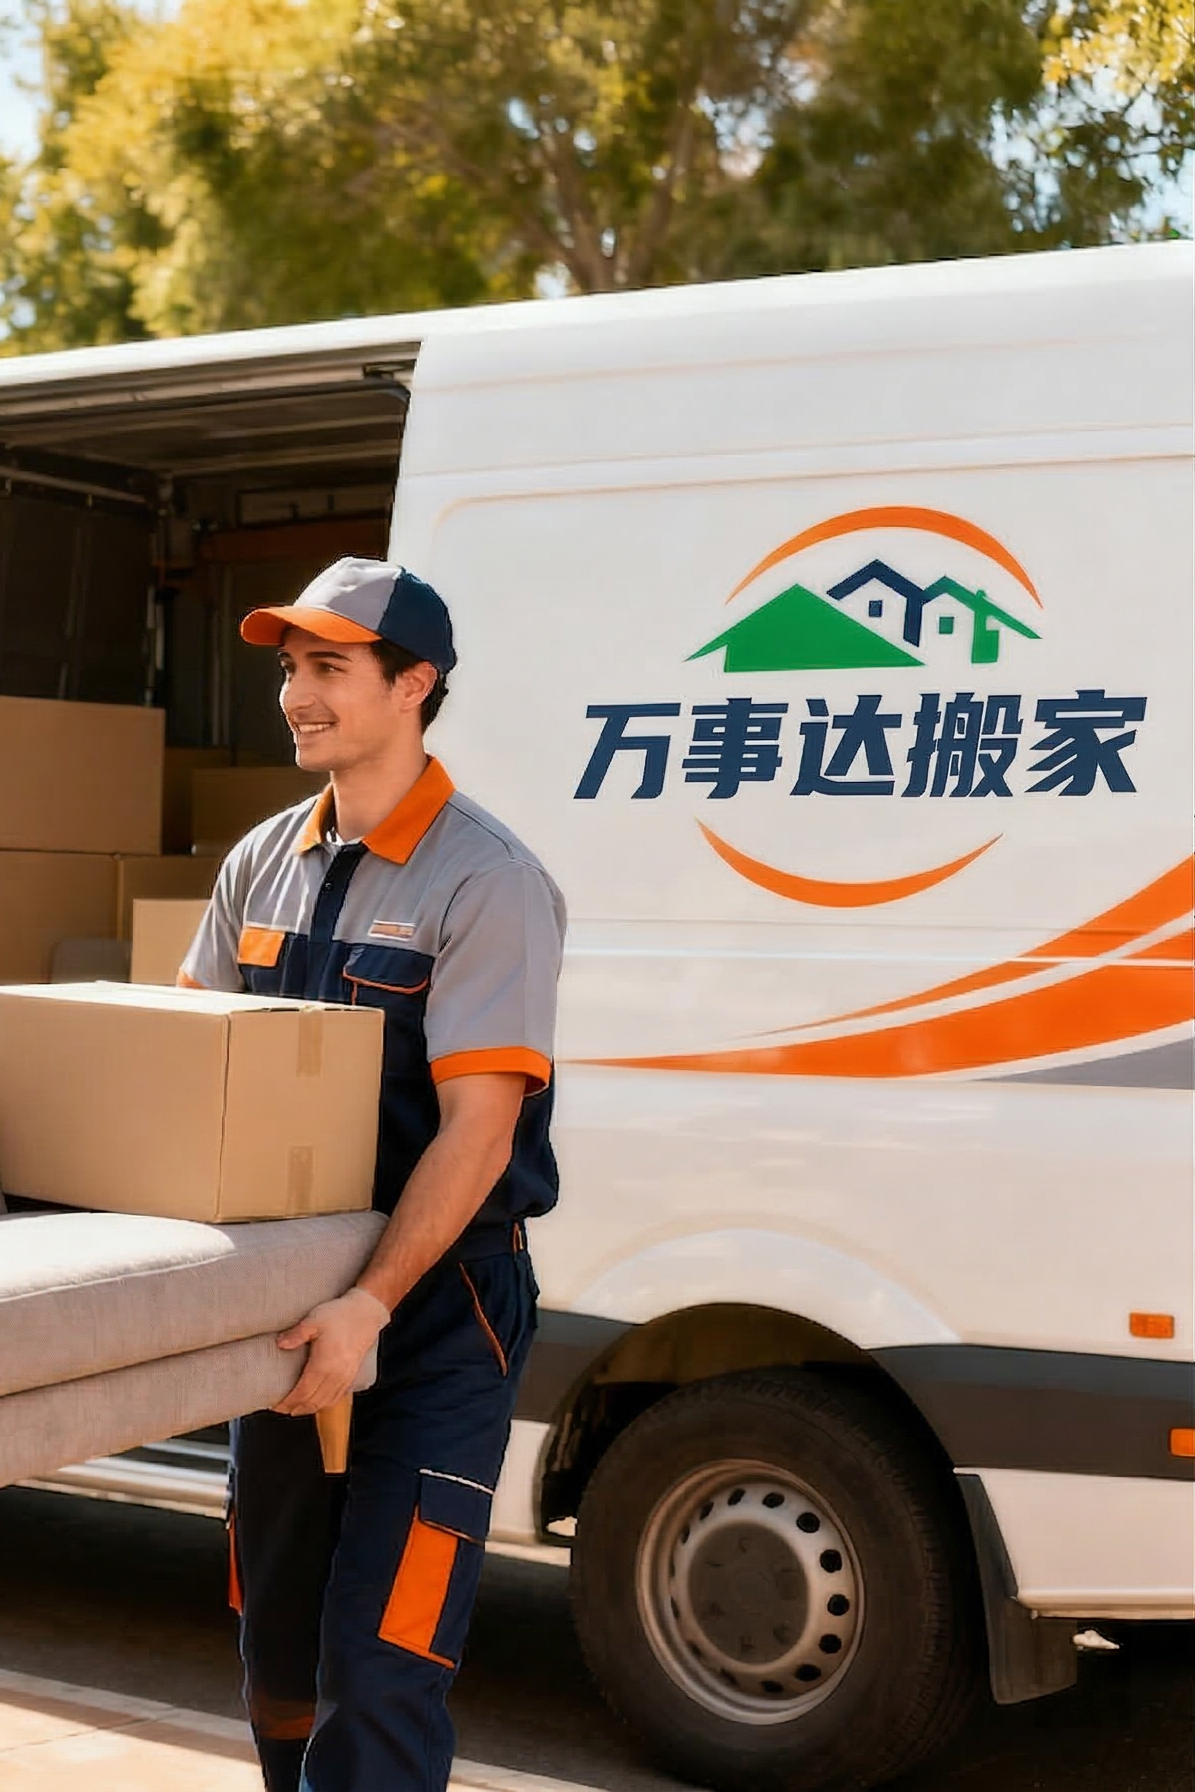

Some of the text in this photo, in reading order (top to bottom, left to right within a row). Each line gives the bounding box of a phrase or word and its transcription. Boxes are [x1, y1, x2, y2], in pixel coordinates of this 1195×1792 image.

[573, 689, 1147, 799] 万事达搬家
